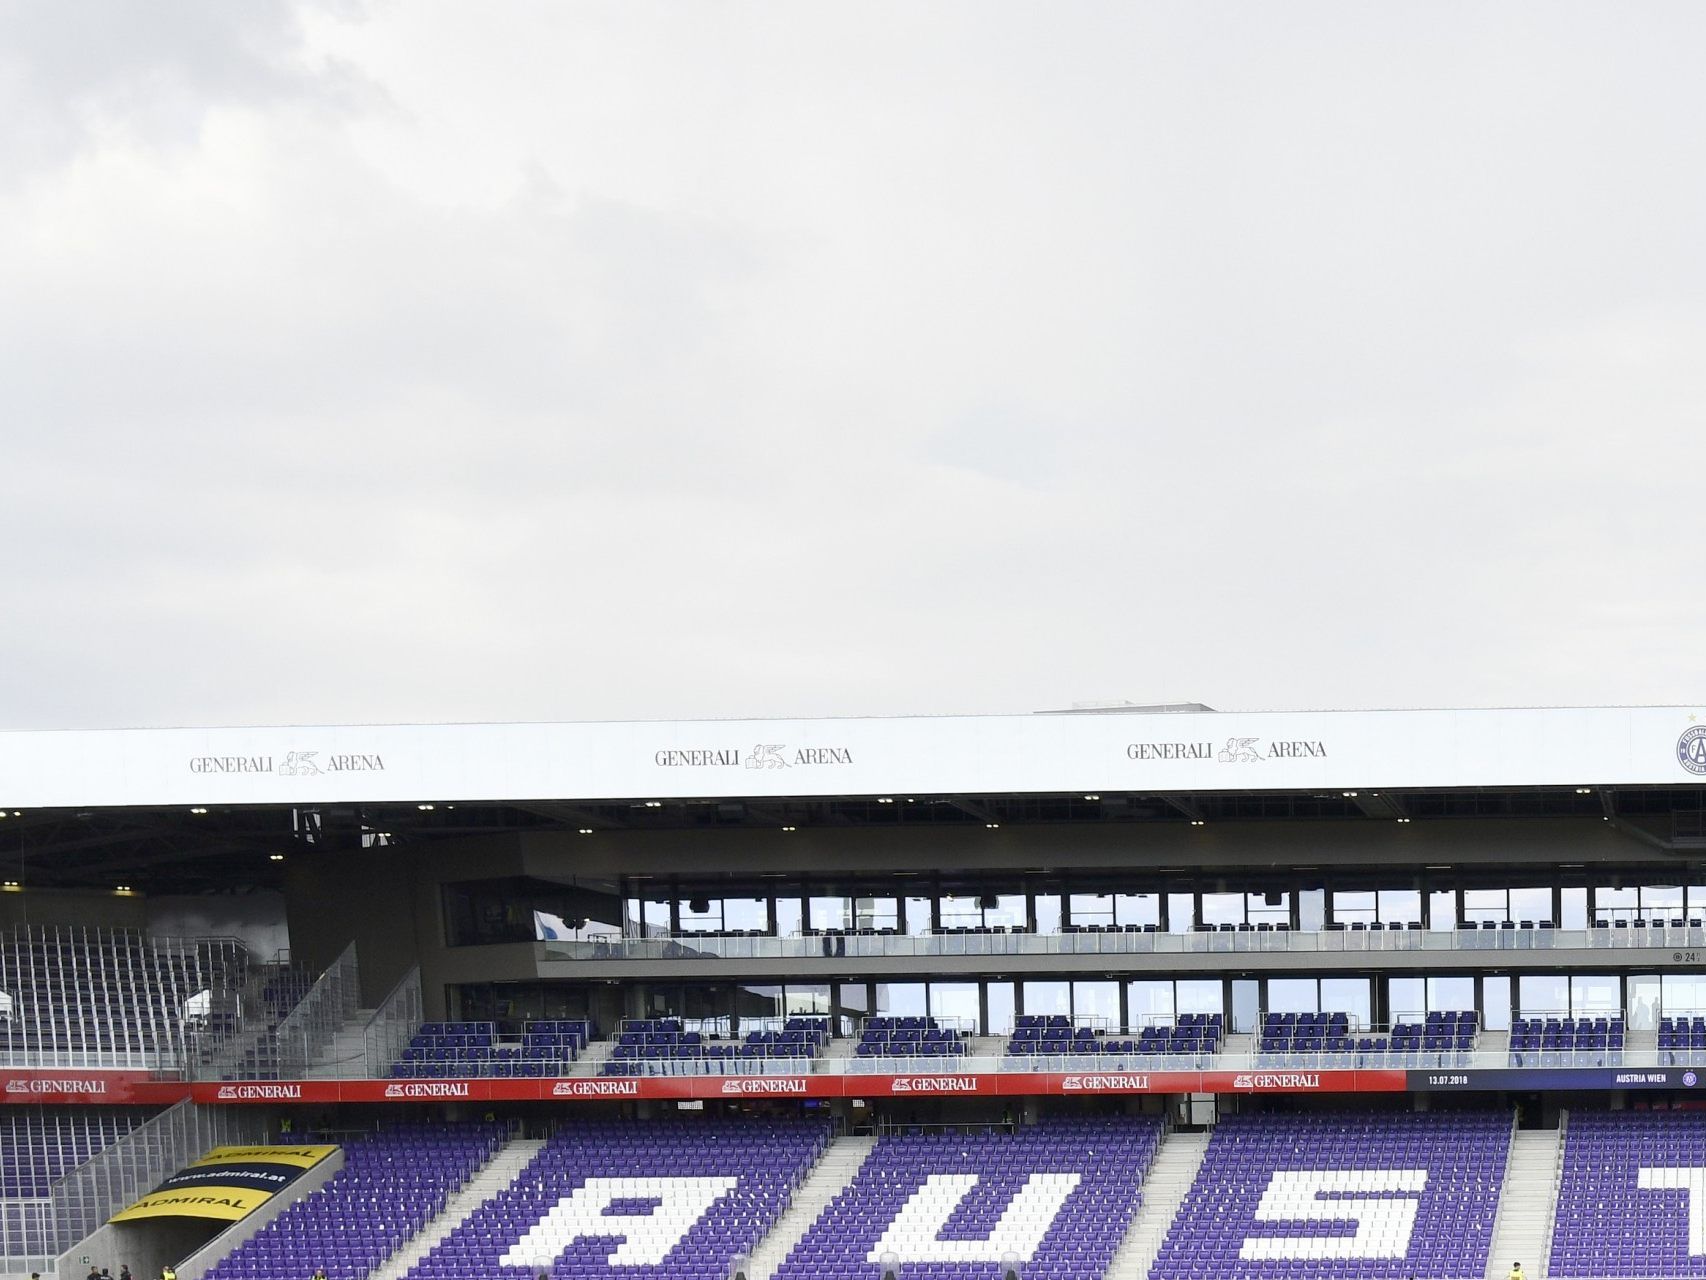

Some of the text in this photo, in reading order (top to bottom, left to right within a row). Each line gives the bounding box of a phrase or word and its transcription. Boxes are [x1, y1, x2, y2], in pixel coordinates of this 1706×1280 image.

[1127, 740, 1327, 760] GENERALI ARENA
[190, 755, 385, 773] GENERALI ARENA
[655, 748, 853, 767] GENERALI ARENA
[1685, 952, 1695, 962] 24
[911, 1078, 977, 1091] GENERALI
[1083, 1076, 1148, 1090] GENERALI
[1254, 1074, 1320, 1088] GENERALI
[1428, 1075, 1468, 1085] 13.07.2018
[1616, 1073, 1667, 1084] AUSTRIA WIEN
[29, 1080, 106, 1093] GENERALI
[237, 1085, 301, 1099] GENERALI
[405, 1083, 469, 1097] GENERALI
[574, 1082, 638, 1095] GENERALI
[742, 1080, 807, 1094] GENERALI
[168, 1169, 287, 1184] www.admiral.at
[132, 1196, 248, 1210] ADMIRAL
